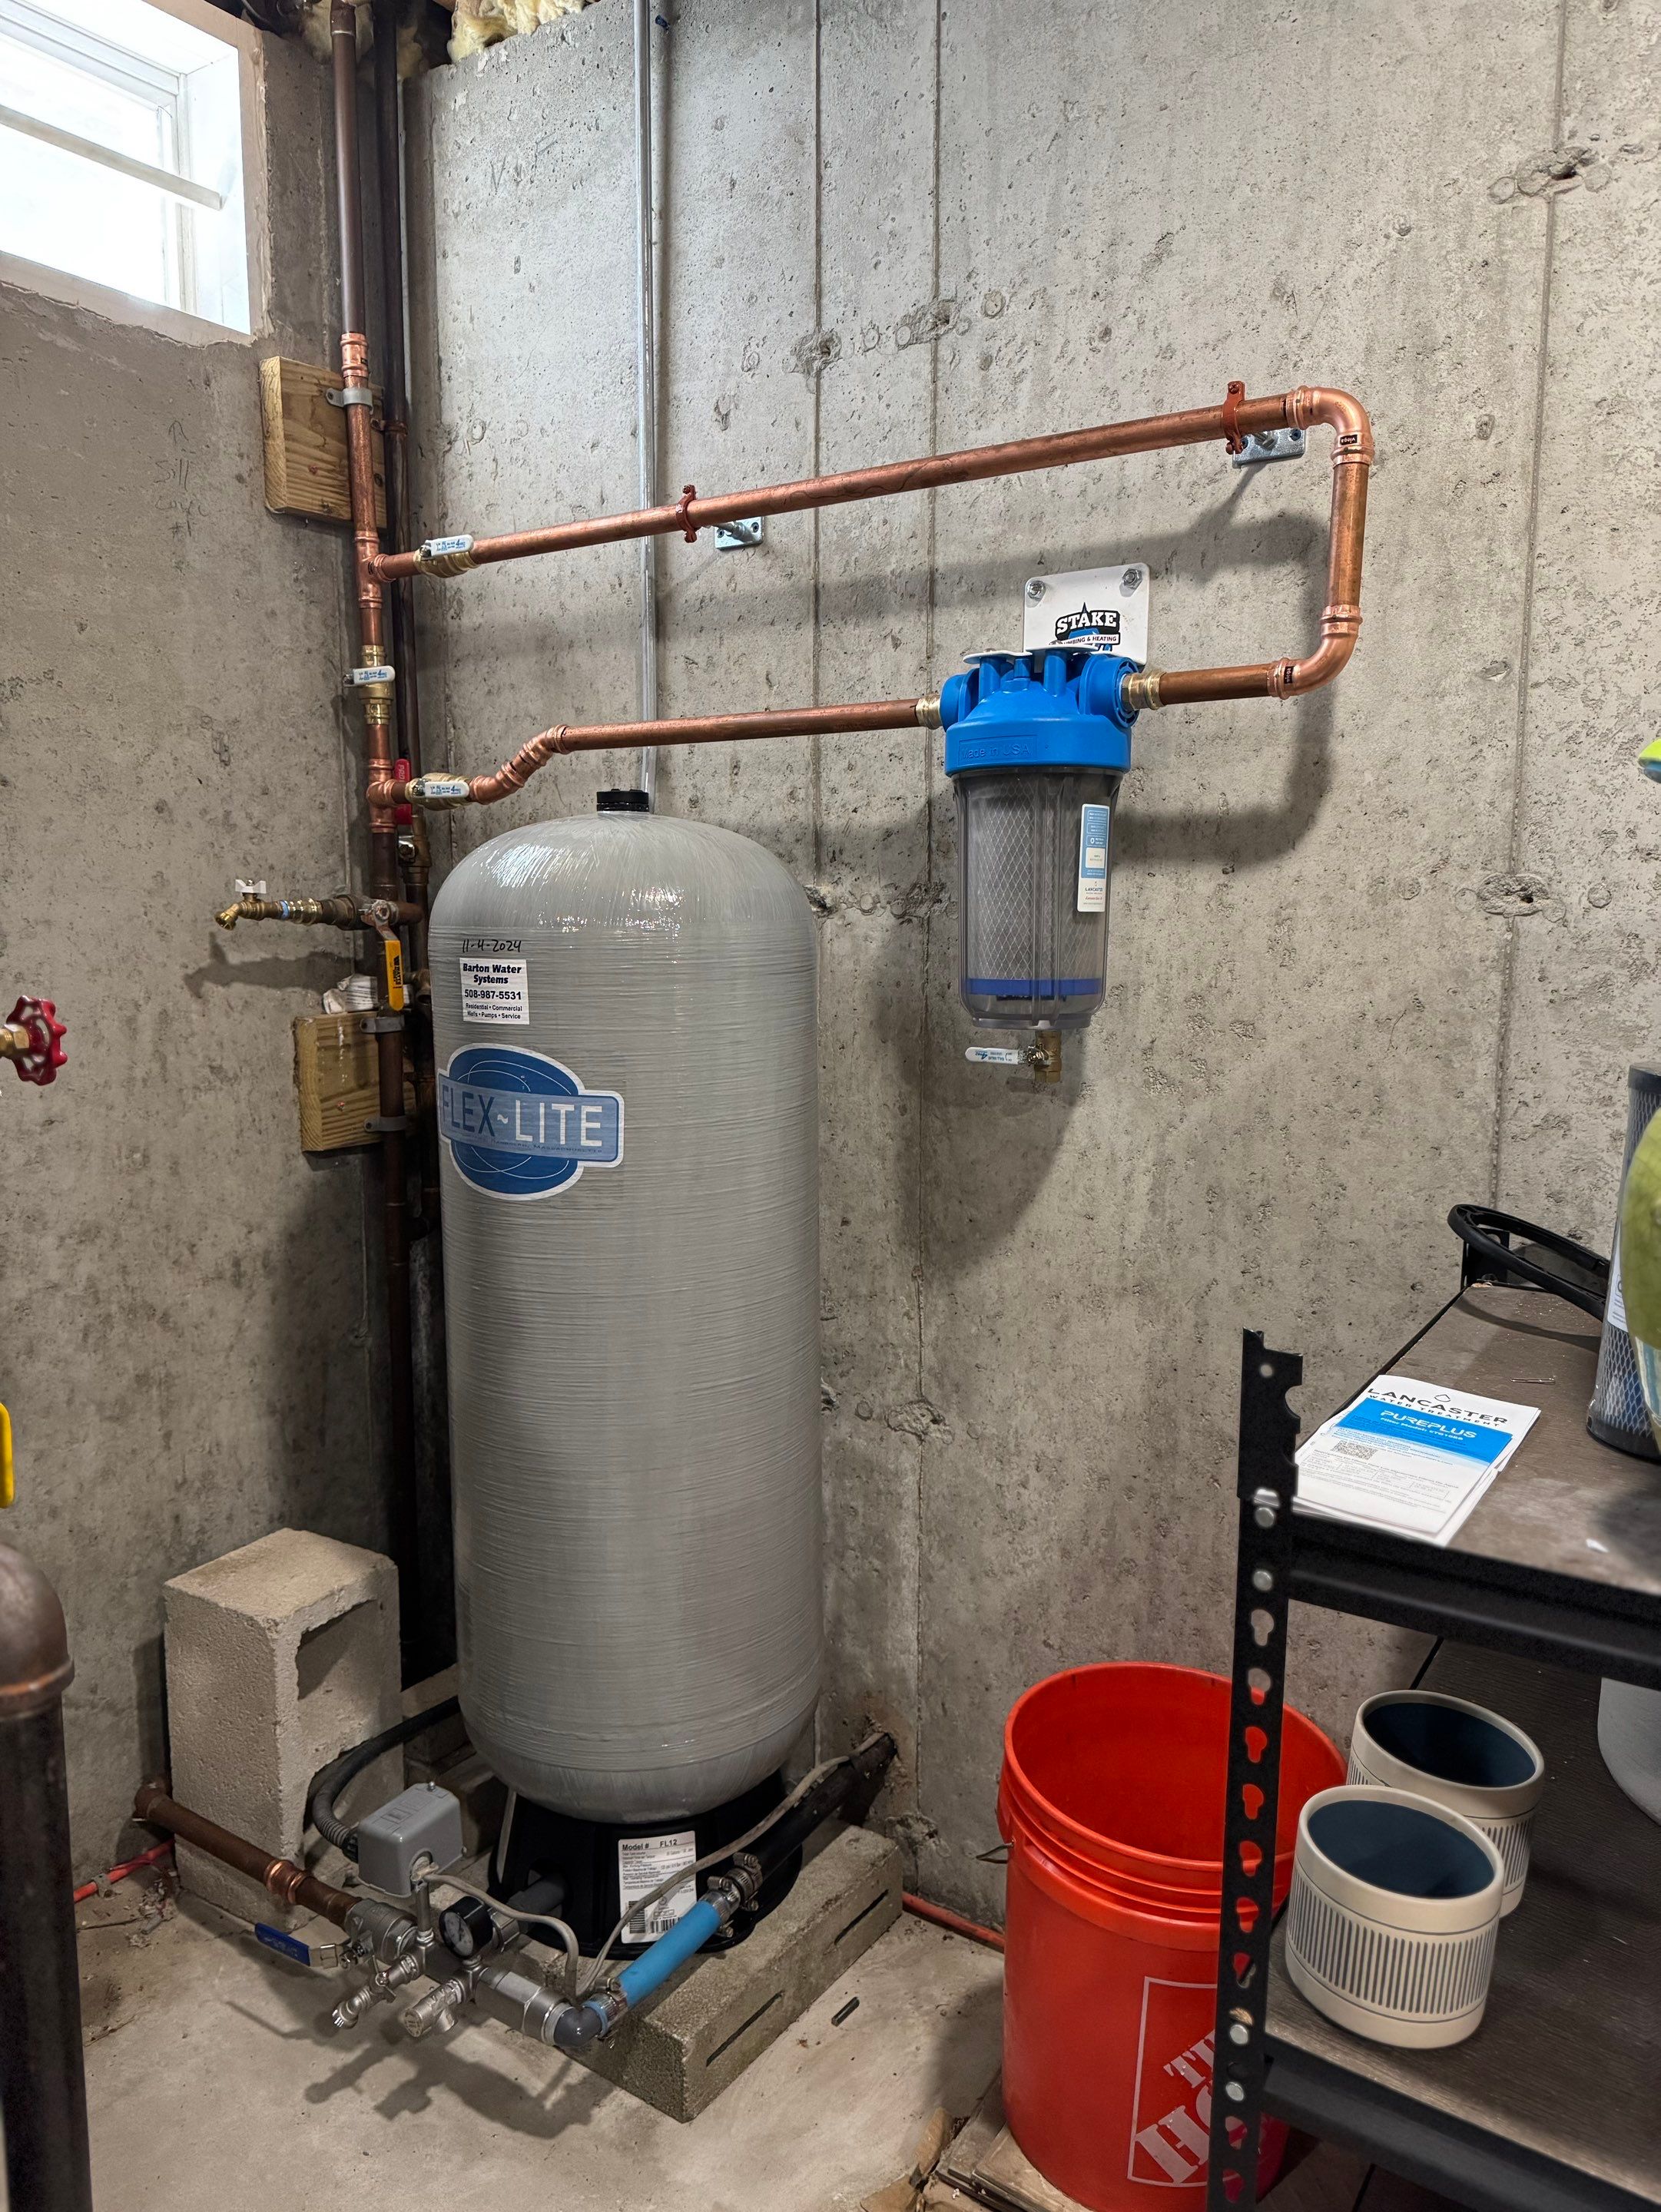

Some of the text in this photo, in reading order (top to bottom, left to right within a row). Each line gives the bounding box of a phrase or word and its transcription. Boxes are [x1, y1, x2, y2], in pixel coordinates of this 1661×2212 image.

[1056, 612, 1117, 634] STAKE
[1003, 743, 1029, 756] USA
[462, 939, 522, 953] 11-4-2024
[462, 963, 522, 974] Barton Water
[473, 975, 509, 985] Systems
[464, 988, 522, 1000] 508-987-5531
[1368, 1388, 1508, 1424] LANCASTER
[1369, 1395, 1500, 1427] WATER TREATMENT
[1380, 1410, 1478, 1439] PUREPLUS
[659, 1839, 678, 1849] FL12
